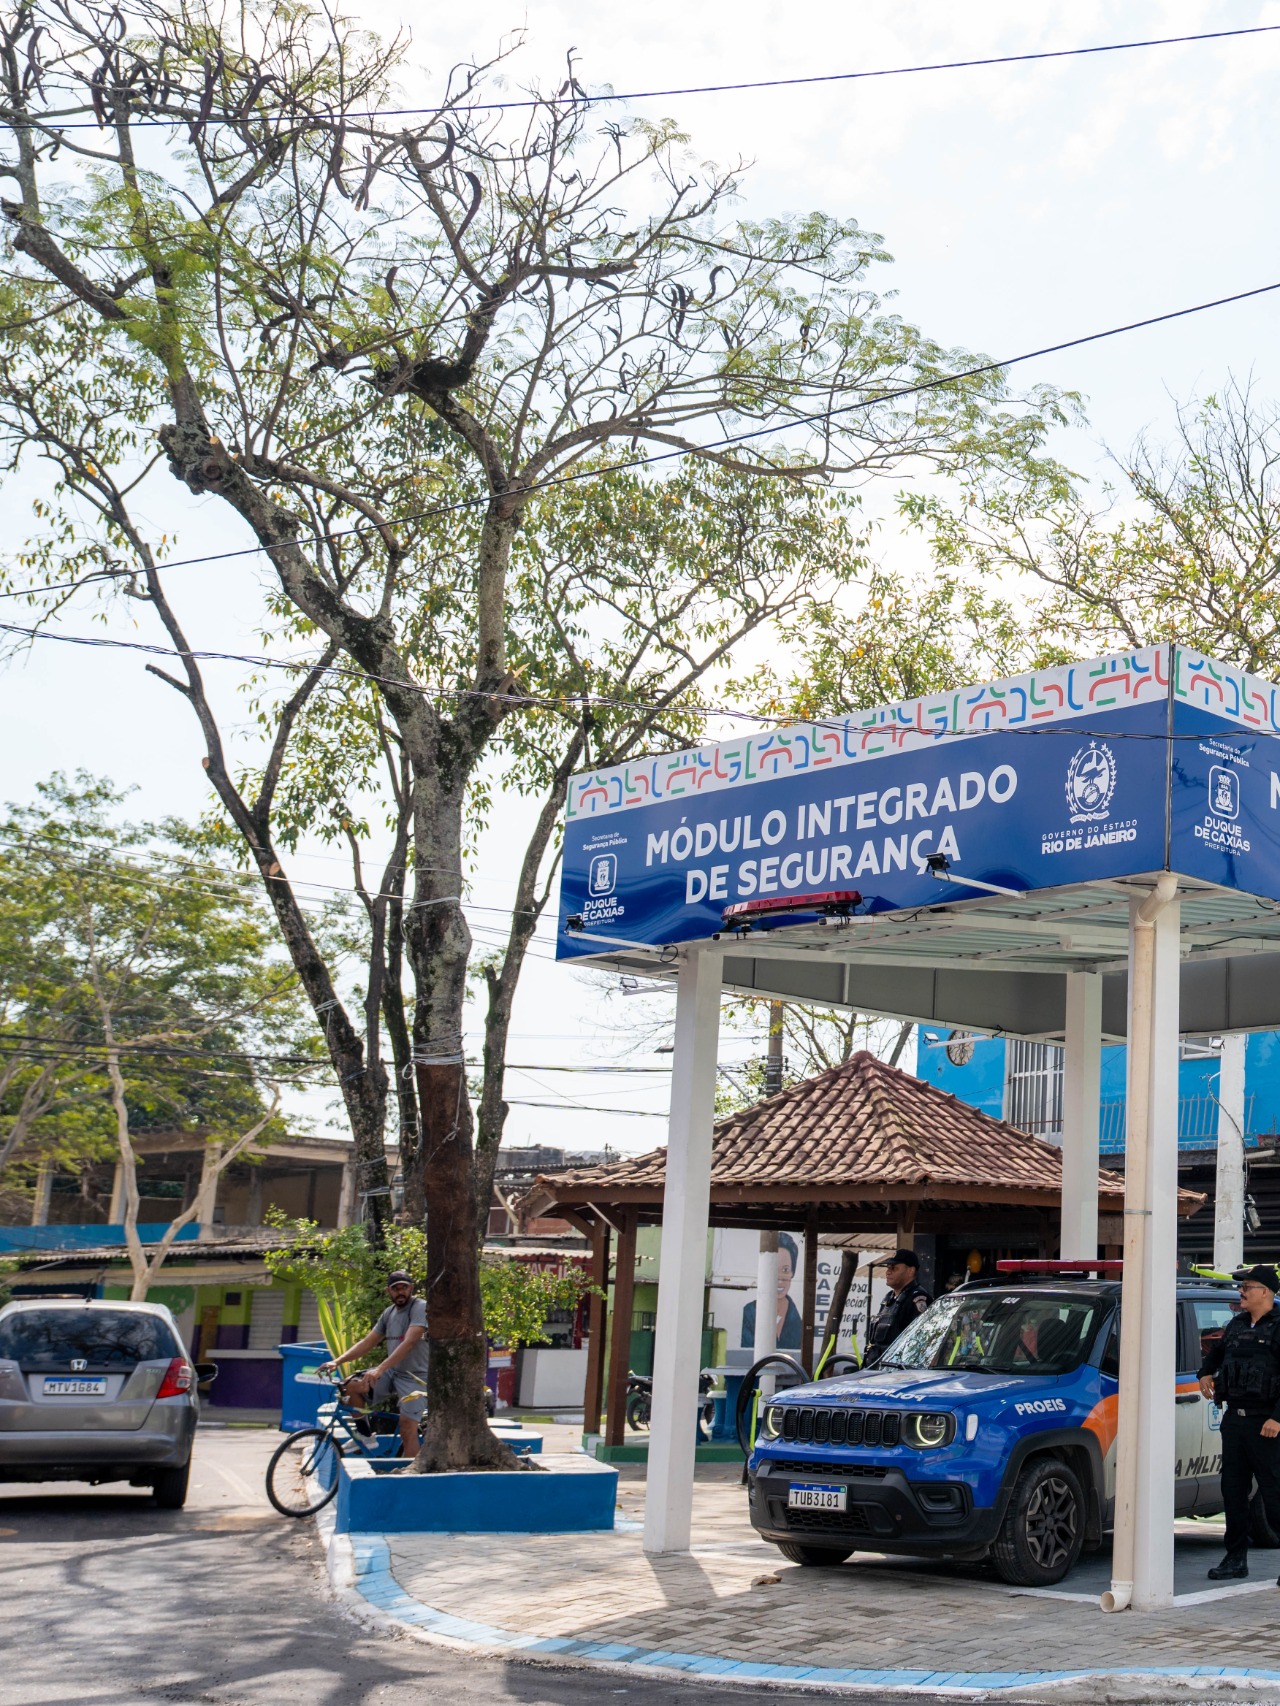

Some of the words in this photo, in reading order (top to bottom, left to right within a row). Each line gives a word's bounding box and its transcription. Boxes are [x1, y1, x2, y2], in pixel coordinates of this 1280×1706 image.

[1199, 743, 1229, 760] Segurança
[1229, 753, 1249, 767] Pública
[645, 809, 787, 867] MÓDULO
[796, 764, 1018, 840] INTEGRADO
[1204, 815, 1242, 838] DUQUE
[1041, 828, 1084, 841] GOVERNO
[1088, 825, 1099, 834] DO
[1103, 819, 1138, 831] ESTADO
[1194, 825, 1210, 840] DE
[1211, 830, 1251, 852] CAXIAS
[582, 840, 609, 851] Segurança
[609, 837, 628, 846] Pública
[1041, 840, 1063, 855] RIO
[1065, 837, 1082, 851] DE
[1084, 828, 1137, 849] JANEIRO
[1204, 841, 1241, 856] PREFEITURA
[685, 864, 730, 904] DE
[736, 825, 962, 896] SEGURANÇA
[584, 896, 618, 911] DUQUE
[589, 906, 625, 920] CAXIAS
[1014, 1398, 1067, 1416] PROEIS
[1185, 1454, 1222, 1476] MILIT
[794, 1491, 839, 1507] TUB3I81
